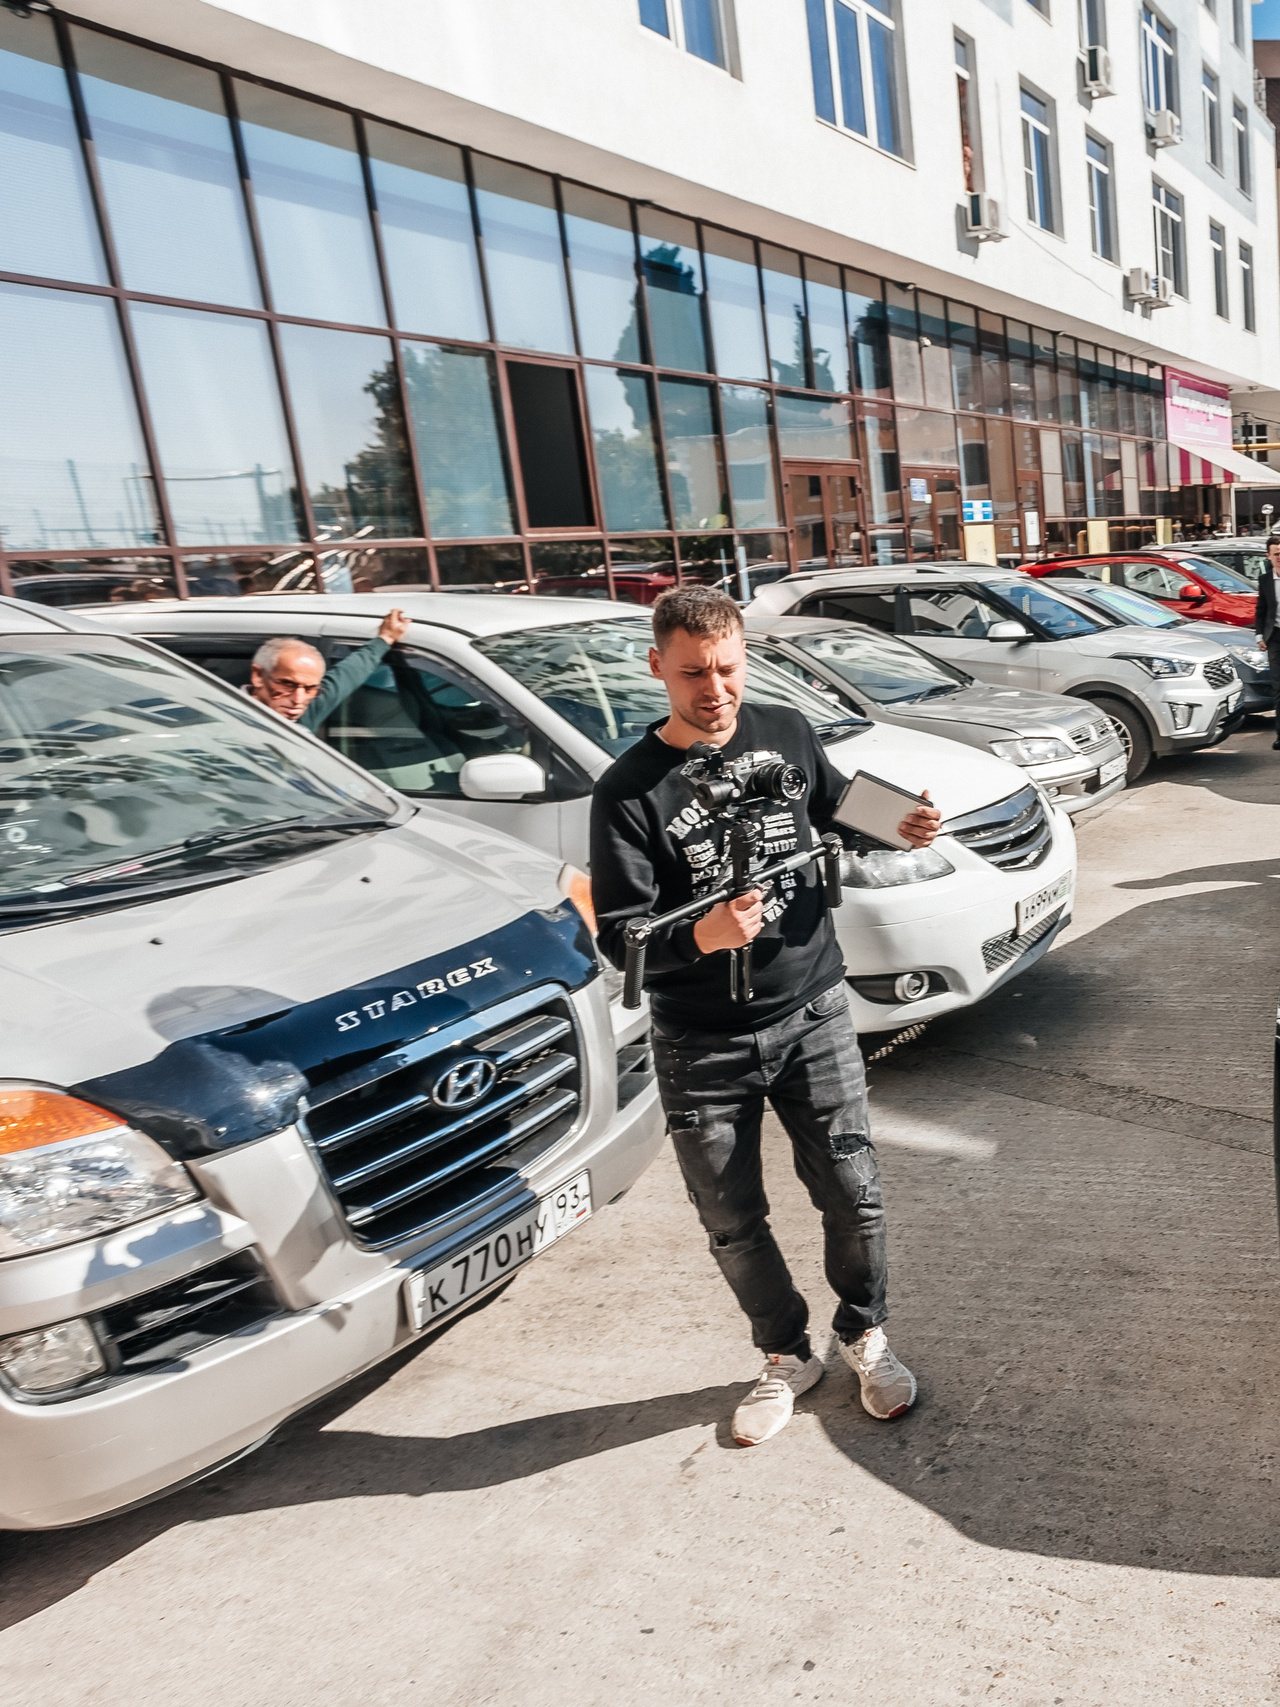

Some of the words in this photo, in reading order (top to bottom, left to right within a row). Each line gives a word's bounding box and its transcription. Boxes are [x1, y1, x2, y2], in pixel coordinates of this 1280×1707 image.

[763, 838, 798, 855] RIDE
[780, 878, 798, 889] USA
[763, 897, 788, 922] WAY
[335, 957, 499, 1032] STAREX
[428, 1213, 548, 1313] К770НУ
[556, 1183, 581, 1220] 93
